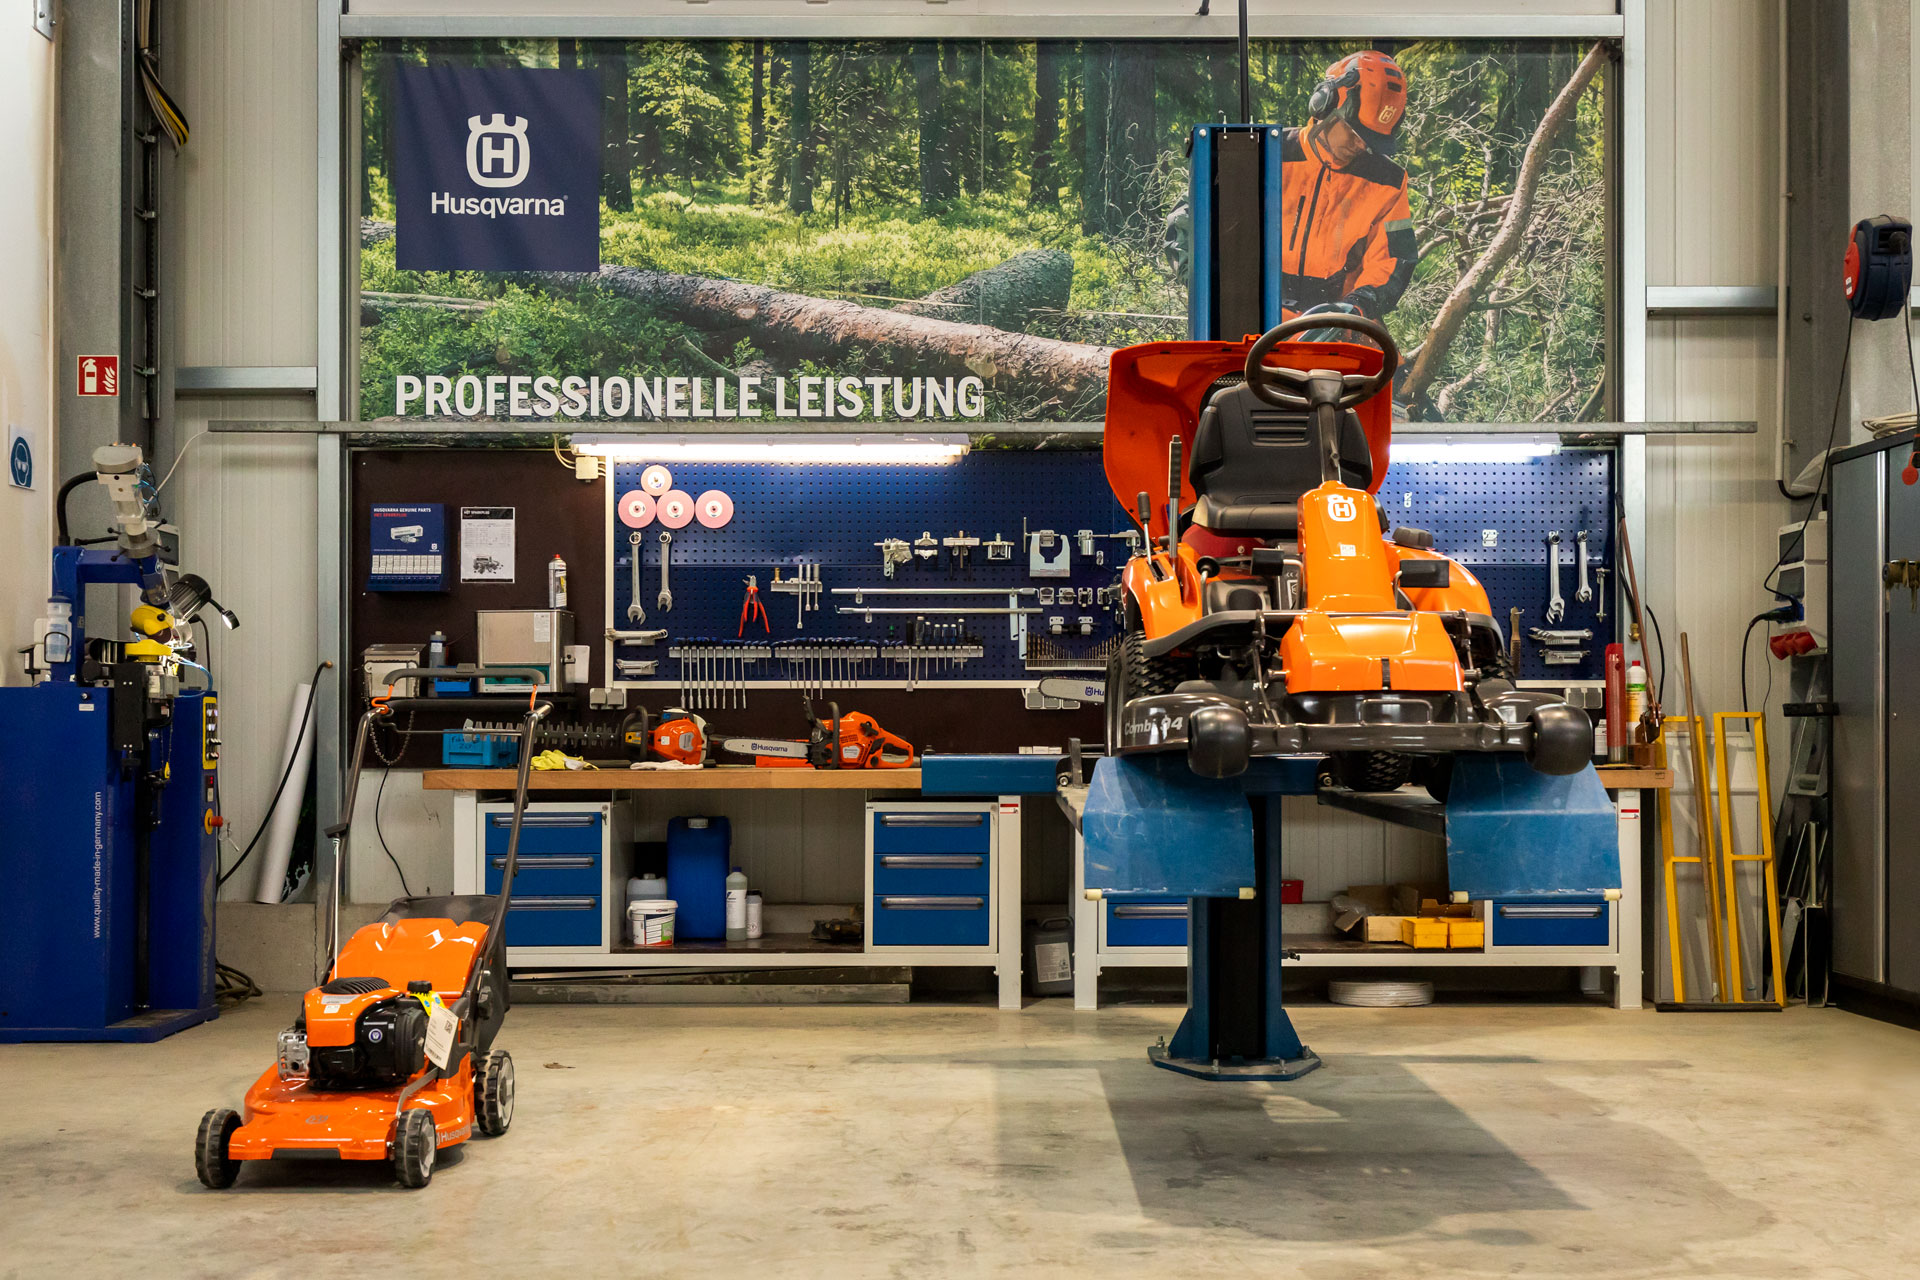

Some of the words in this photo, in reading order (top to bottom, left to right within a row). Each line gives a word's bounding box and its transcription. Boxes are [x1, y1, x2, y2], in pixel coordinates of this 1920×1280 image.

[431, 192, 565, 219] Husqvarna
[395, 375, 763, 418] PROFESSIONELLE
[775, 376, 986, 418] LEISTUNG
[1124, 718, 1157, 736] Combi
[1160, 714, 1184, 731] 94
[757, 743, 788, 753] Husqvarna
[92, 791, 104, 939] www.quality-made-in-germany.com
